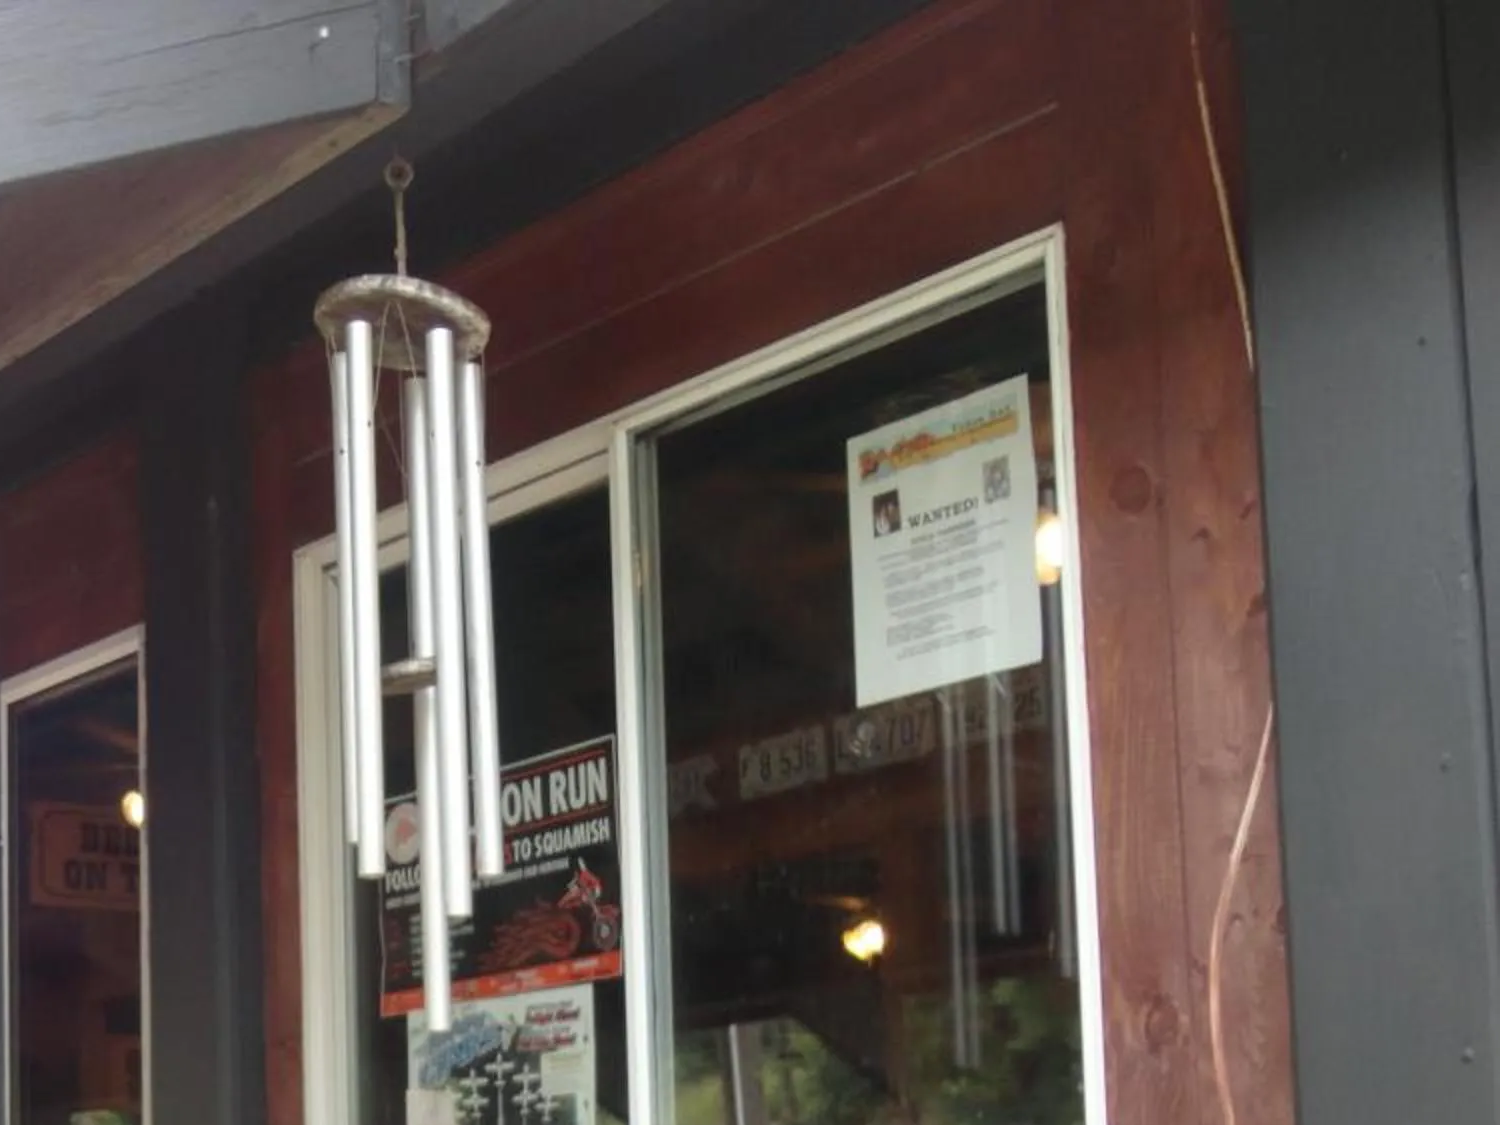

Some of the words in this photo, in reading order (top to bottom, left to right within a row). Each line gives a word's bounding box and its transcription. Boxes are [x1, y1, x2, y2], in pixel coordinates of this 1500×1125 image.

[550, 756, 609, 815] RUN
[513, 836, 532, 863] TO
[534, 815, 610, 858] SQUAMISH
